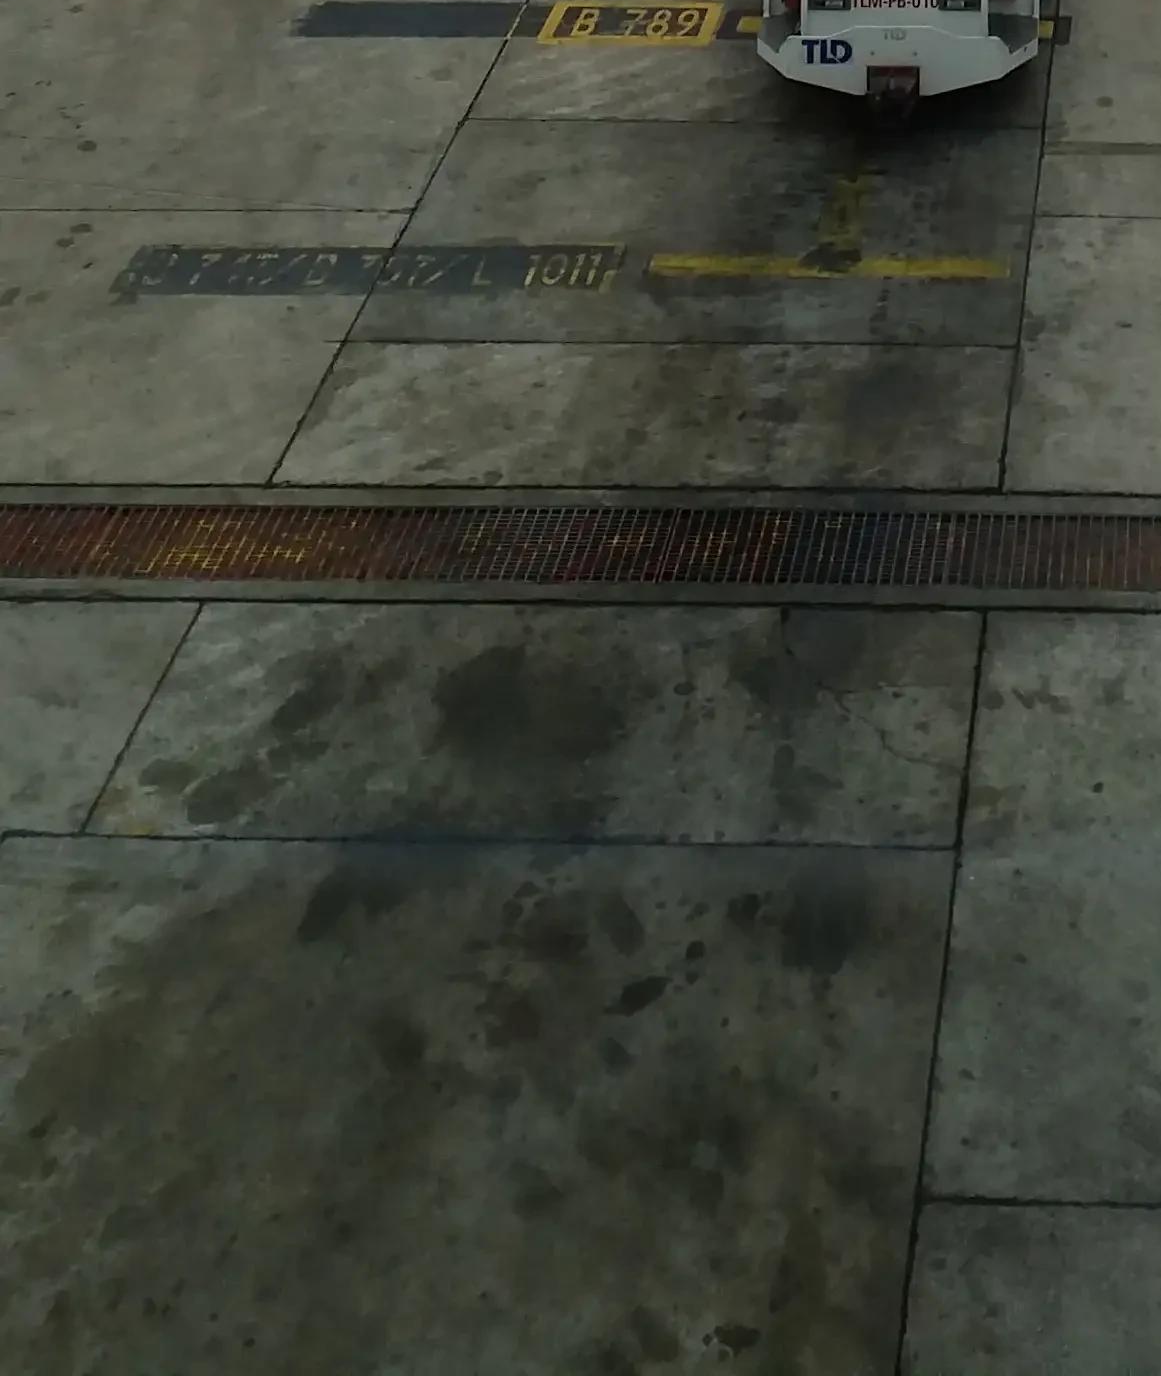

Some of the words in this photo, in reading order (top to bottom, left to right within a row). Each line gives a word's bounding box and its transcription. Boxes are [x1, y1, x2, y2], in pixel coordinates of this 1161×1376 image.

[569, 7, 598, 36] B
[621, 9, 699, 37] 789
[801, 39, 853, 64] TLD
